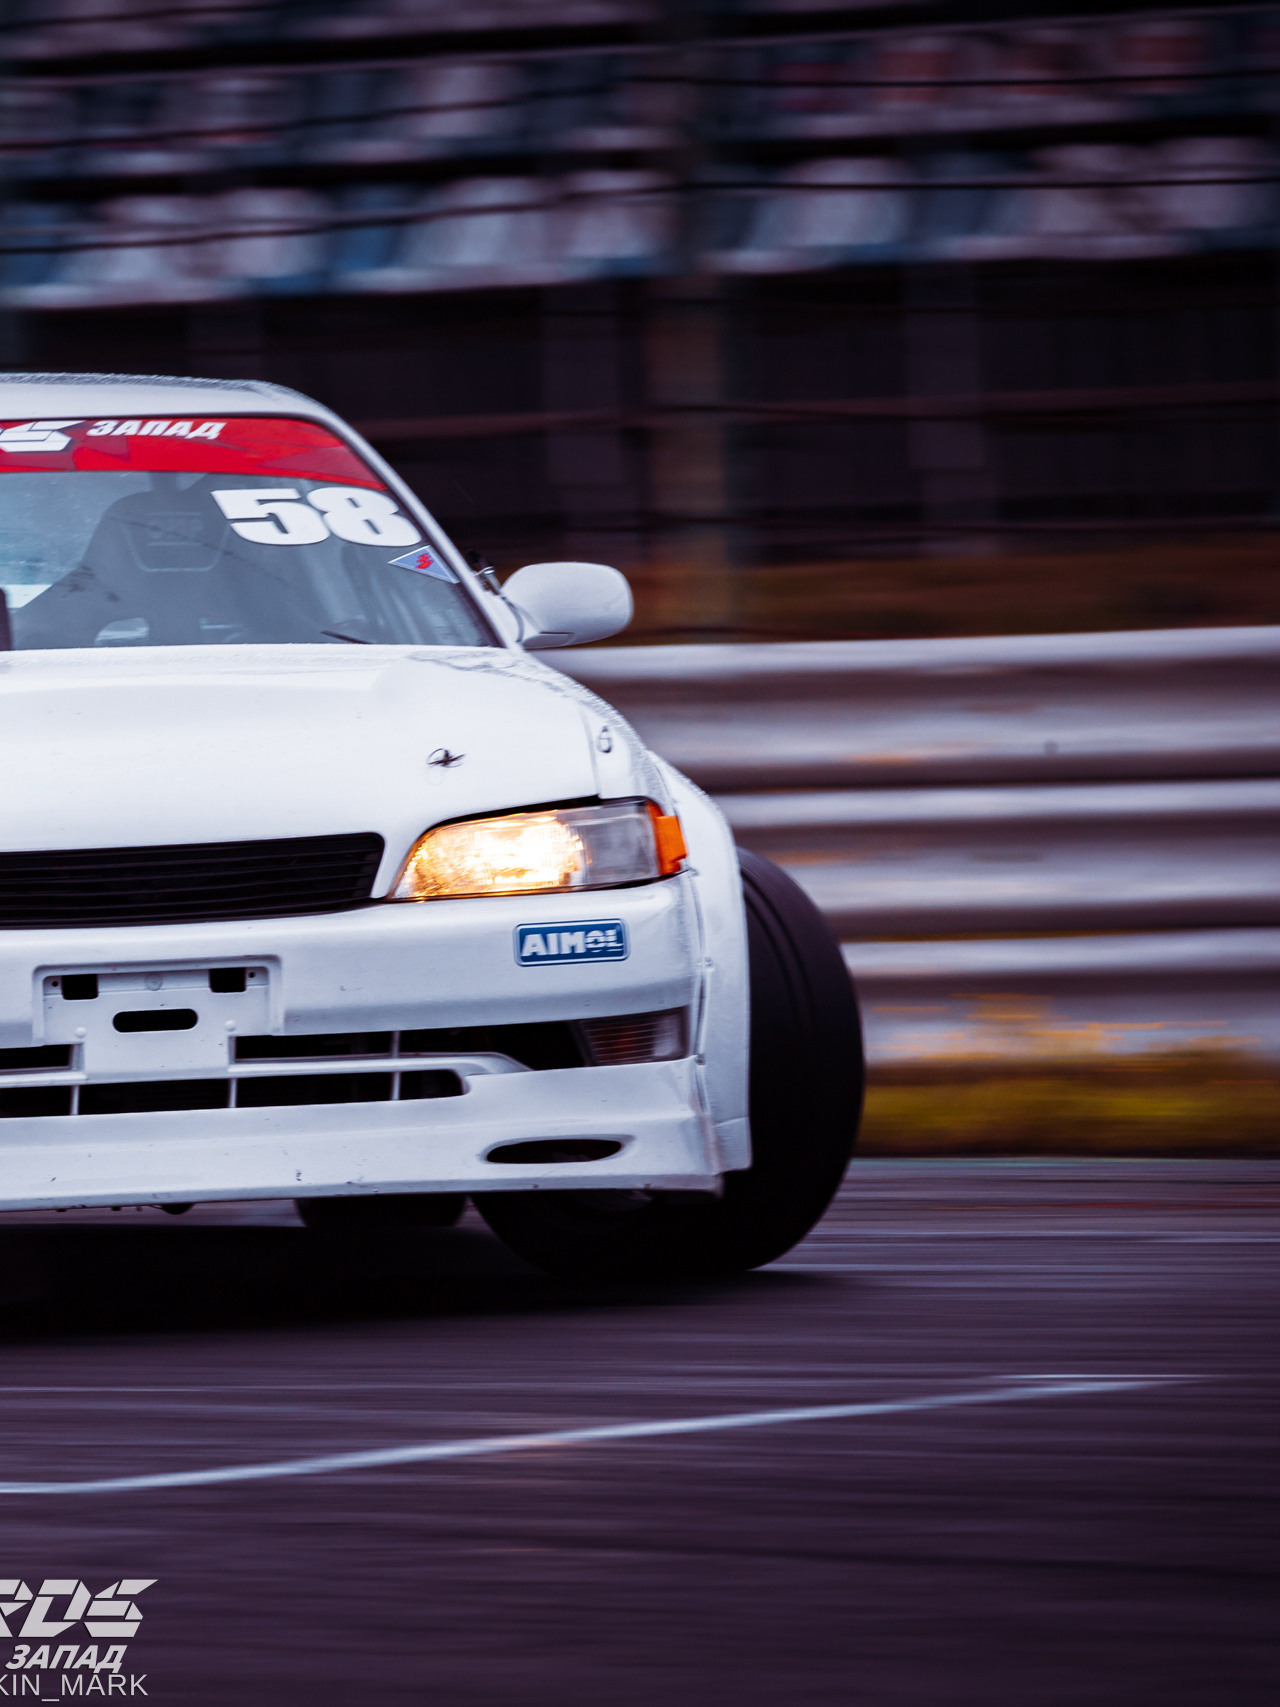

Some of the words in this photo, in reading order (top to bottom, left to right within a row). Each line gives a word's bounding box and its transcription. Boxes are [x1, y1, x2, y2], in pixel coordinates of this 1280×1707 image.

[86, 419, 228, 441] ЗАПАД
[210, 486, 422, 547] 58
[521, 929, 624, 956] AIMOL
